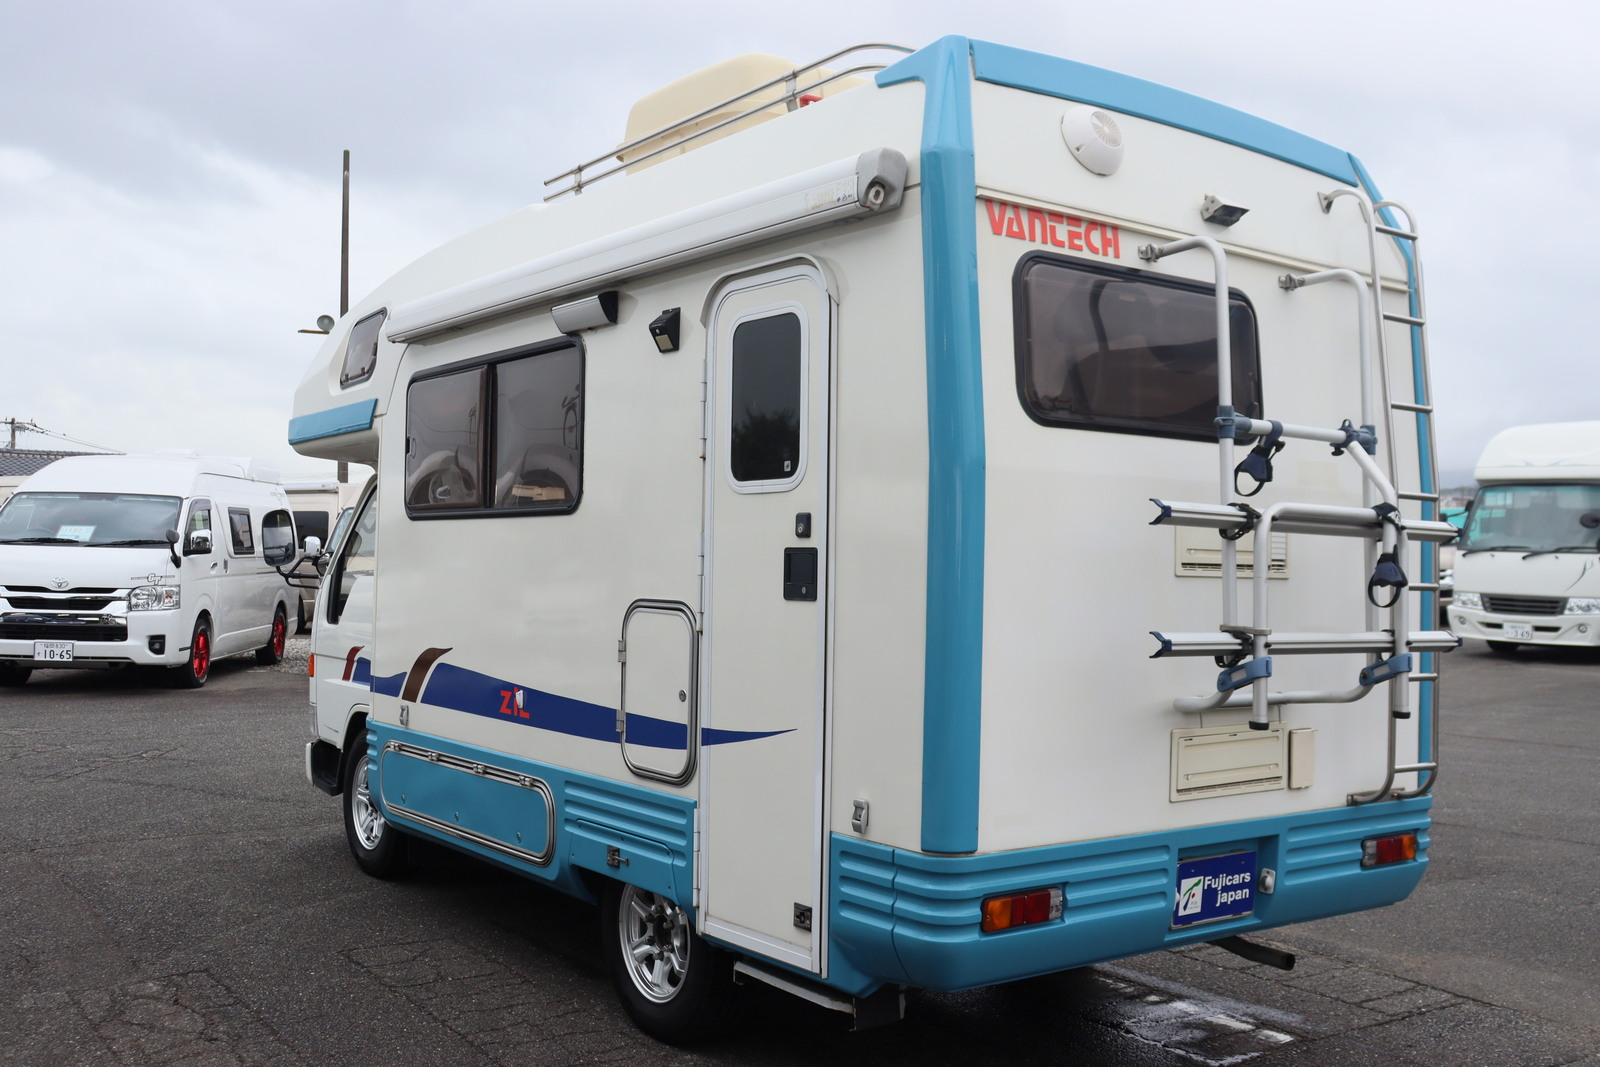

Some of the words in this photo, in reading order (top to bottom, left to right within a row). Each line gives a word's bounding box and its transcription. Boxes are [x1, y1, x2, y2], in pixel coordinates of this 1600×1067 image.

[985, 199, 1121, 259] VANTECH
[44, 649, 72, 660] 10-65
[1204, 872, 1251, 890] Fujicars
[1216, 888, 1250, 907] japan
